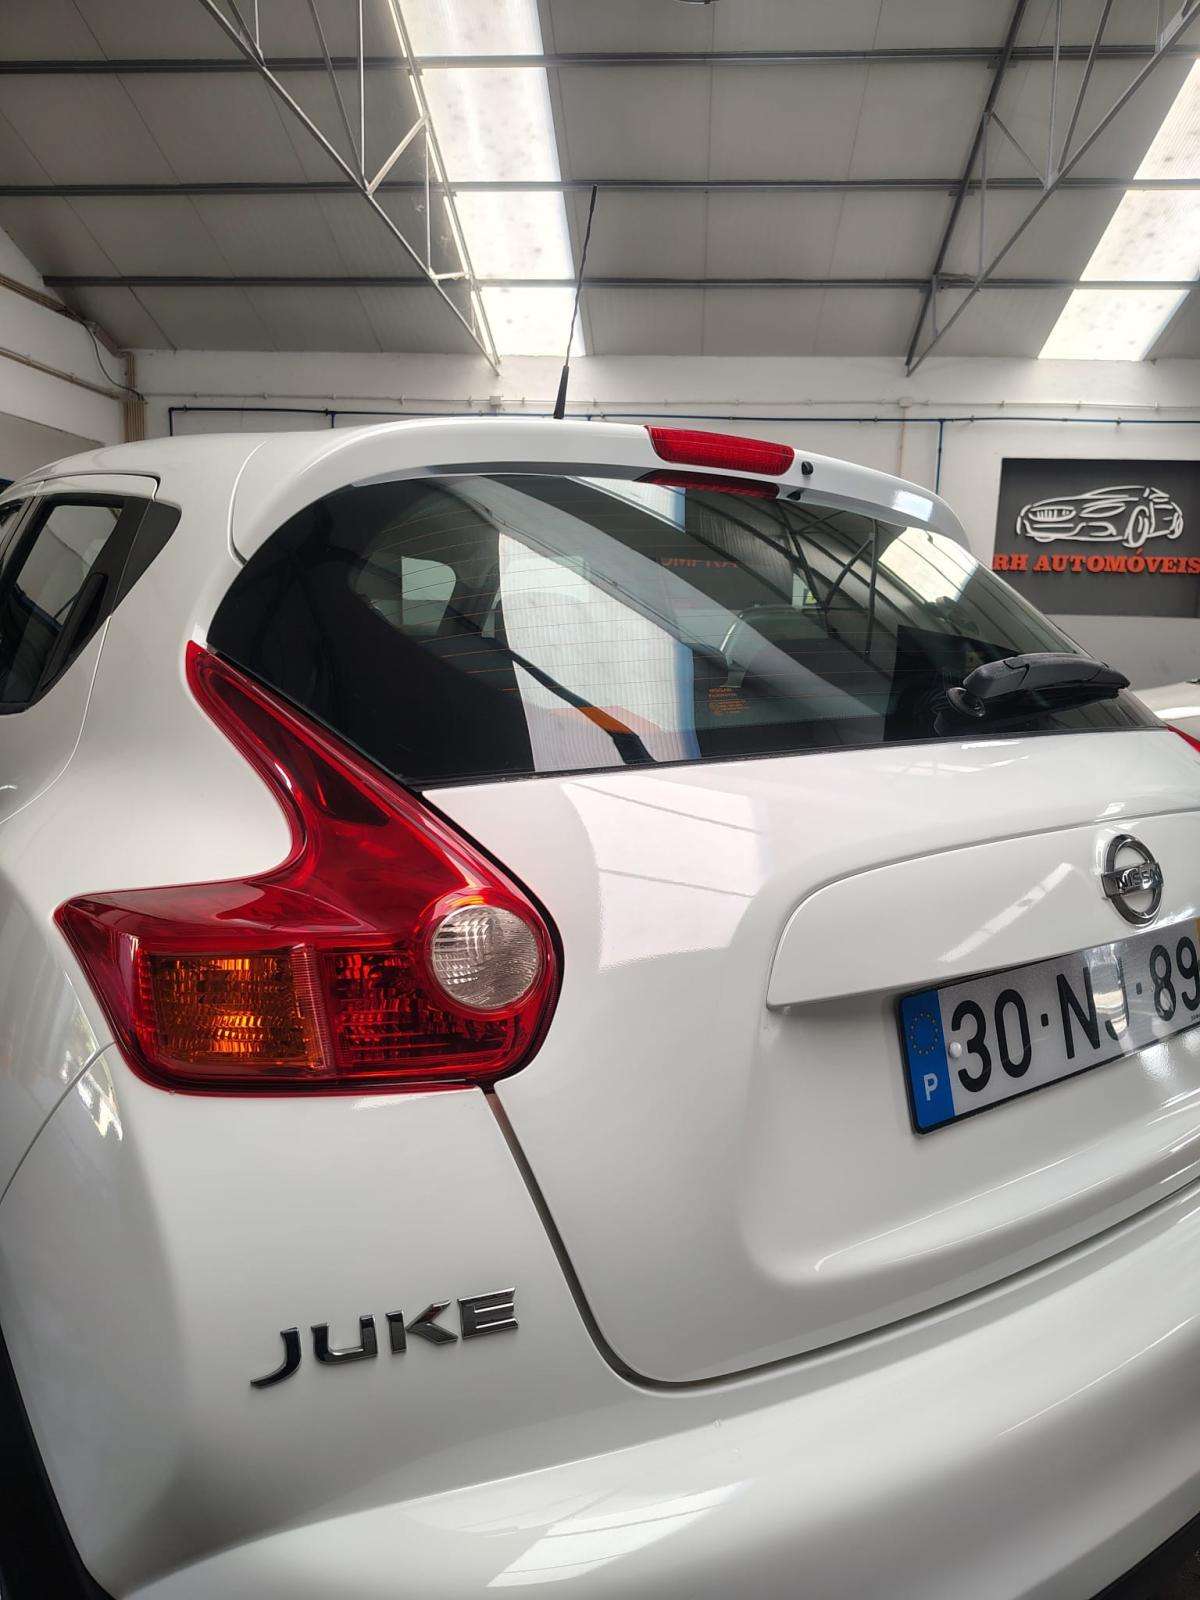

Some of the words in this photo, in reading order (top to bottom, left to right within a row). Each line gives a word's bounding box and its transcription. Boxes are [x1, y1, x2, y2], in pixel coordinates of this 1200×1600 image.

[993, 553, 1028, 572] RH
[1032, 548, 1200, 574] AUTOMÓVEIS
[923, 1072, 938, 1101] P
[250, 1287, 519, 1389] JUKE
